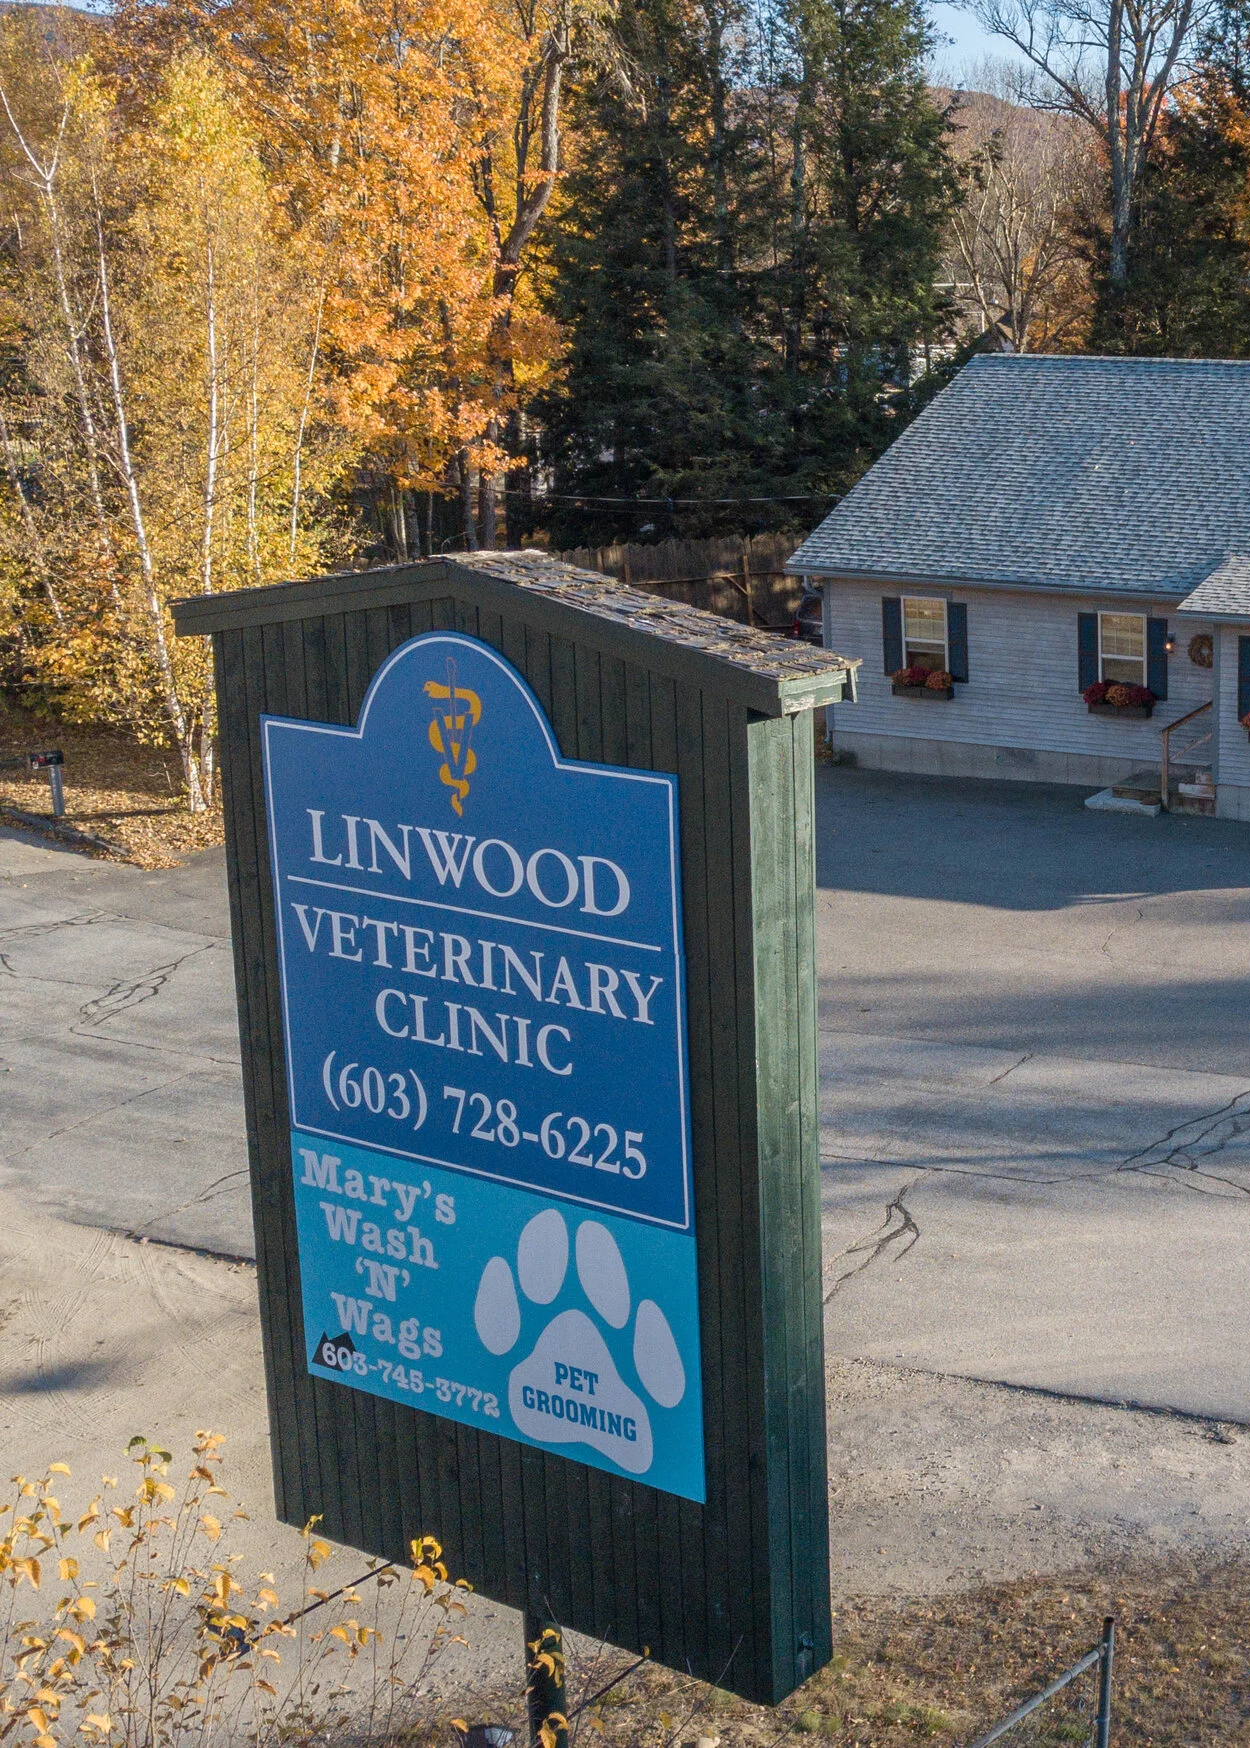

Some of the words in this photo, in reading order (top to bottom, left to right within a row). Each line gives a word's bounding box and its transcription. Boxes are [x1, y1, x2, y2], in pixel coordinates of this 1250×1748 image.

[306, 808, 631, 916] LINWOOD
[291, 903, 663, 1025] VETERINARY
[375, 989, 573, 1076] CLINIC
[322, 1051, 428, 1130] (603)
[443, 1085, 648, 1180] 728-6225
[299, 1148, 457, 1225] Mary's
[319, 1201, 439, 1270] Wash
[330, 1292, 444, 1360] Wags
[322, 1342, 500, 1418] 603-745-3772
[521, 1385, 637, 1443] GROOMING
[553, 1361, 599, 1396] PET
